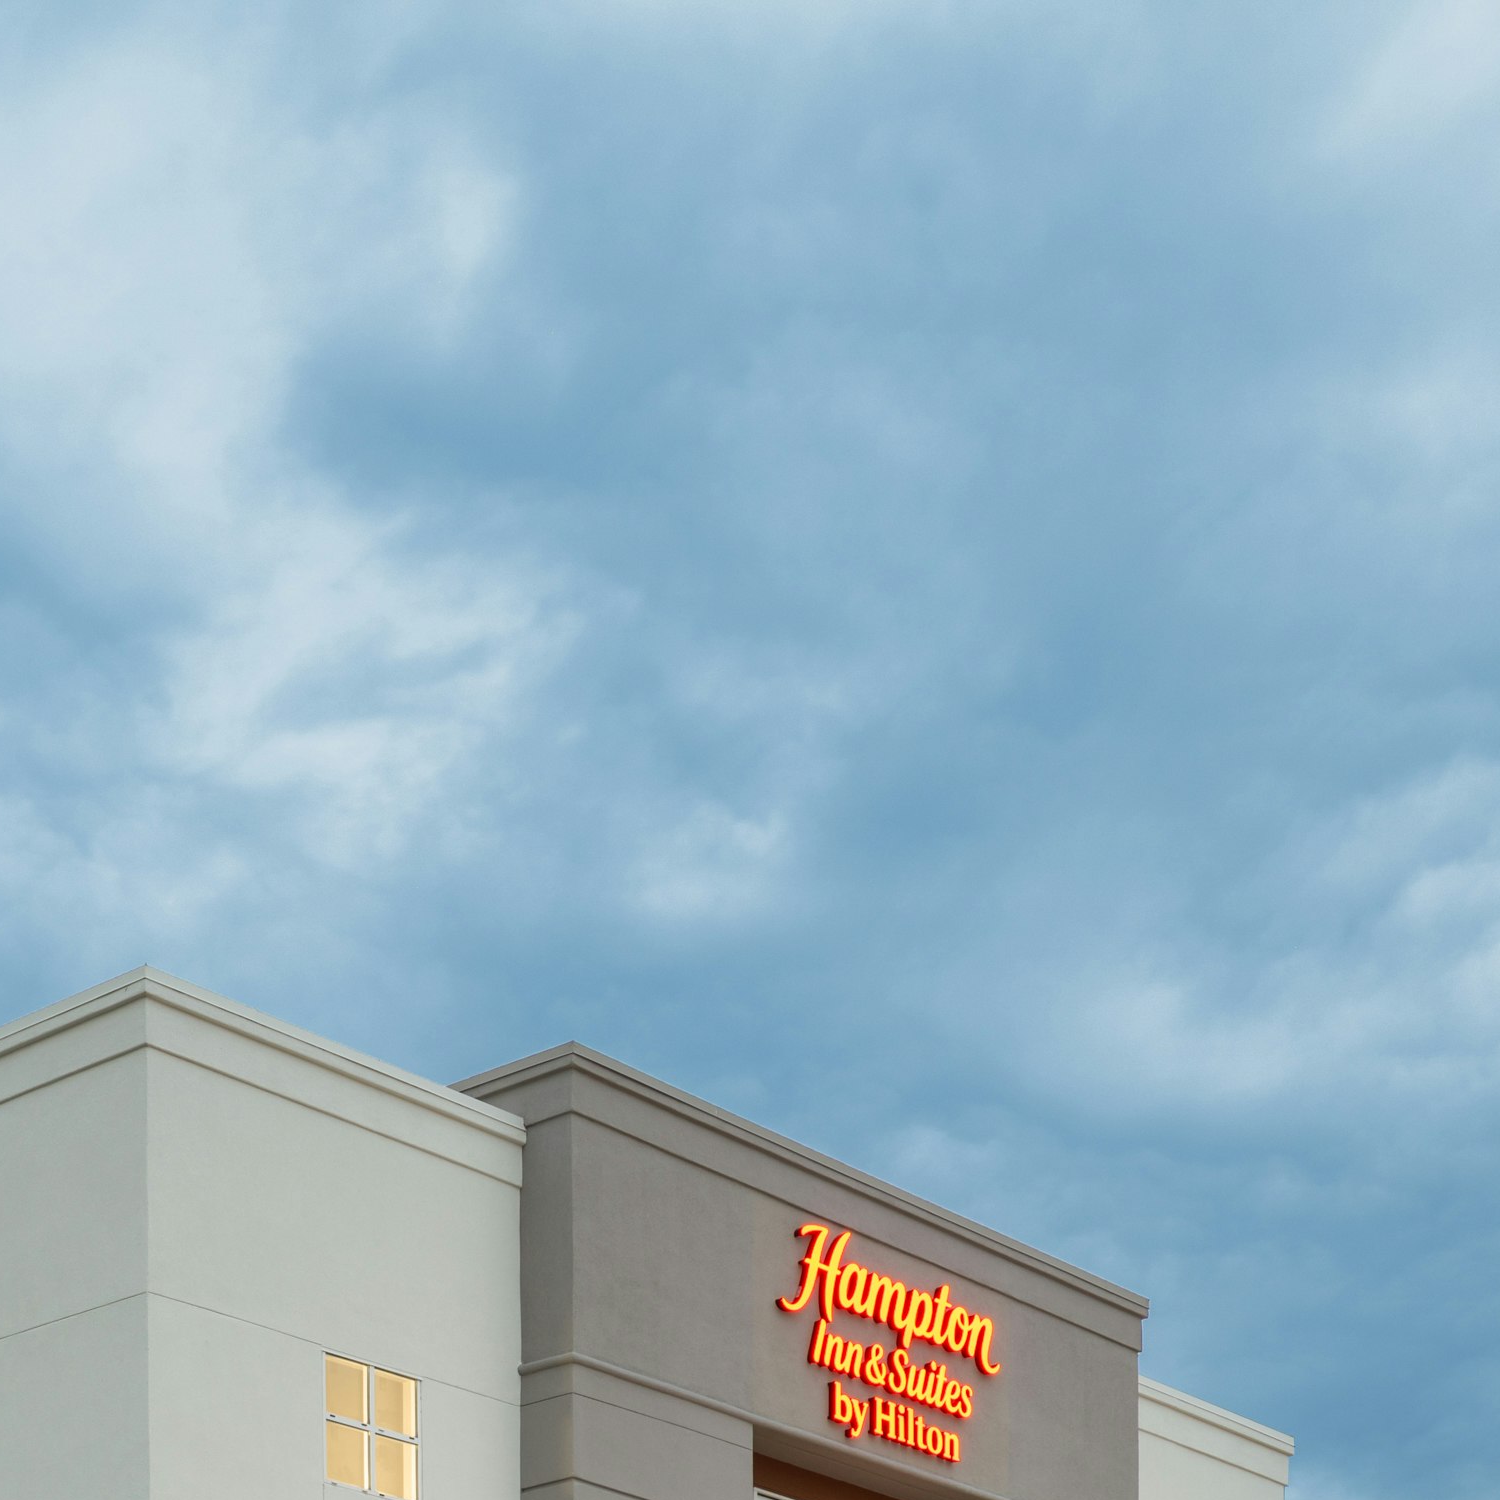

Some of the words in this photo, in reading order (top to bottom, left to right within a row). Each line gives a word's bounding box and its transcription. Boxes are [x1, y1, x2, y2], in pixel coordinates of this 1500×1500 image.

[776, 1223, 1001, 1377] Hampton
[828, 1380, 870, 1438] by
[868, 1396, 961, 1463] Hilton
